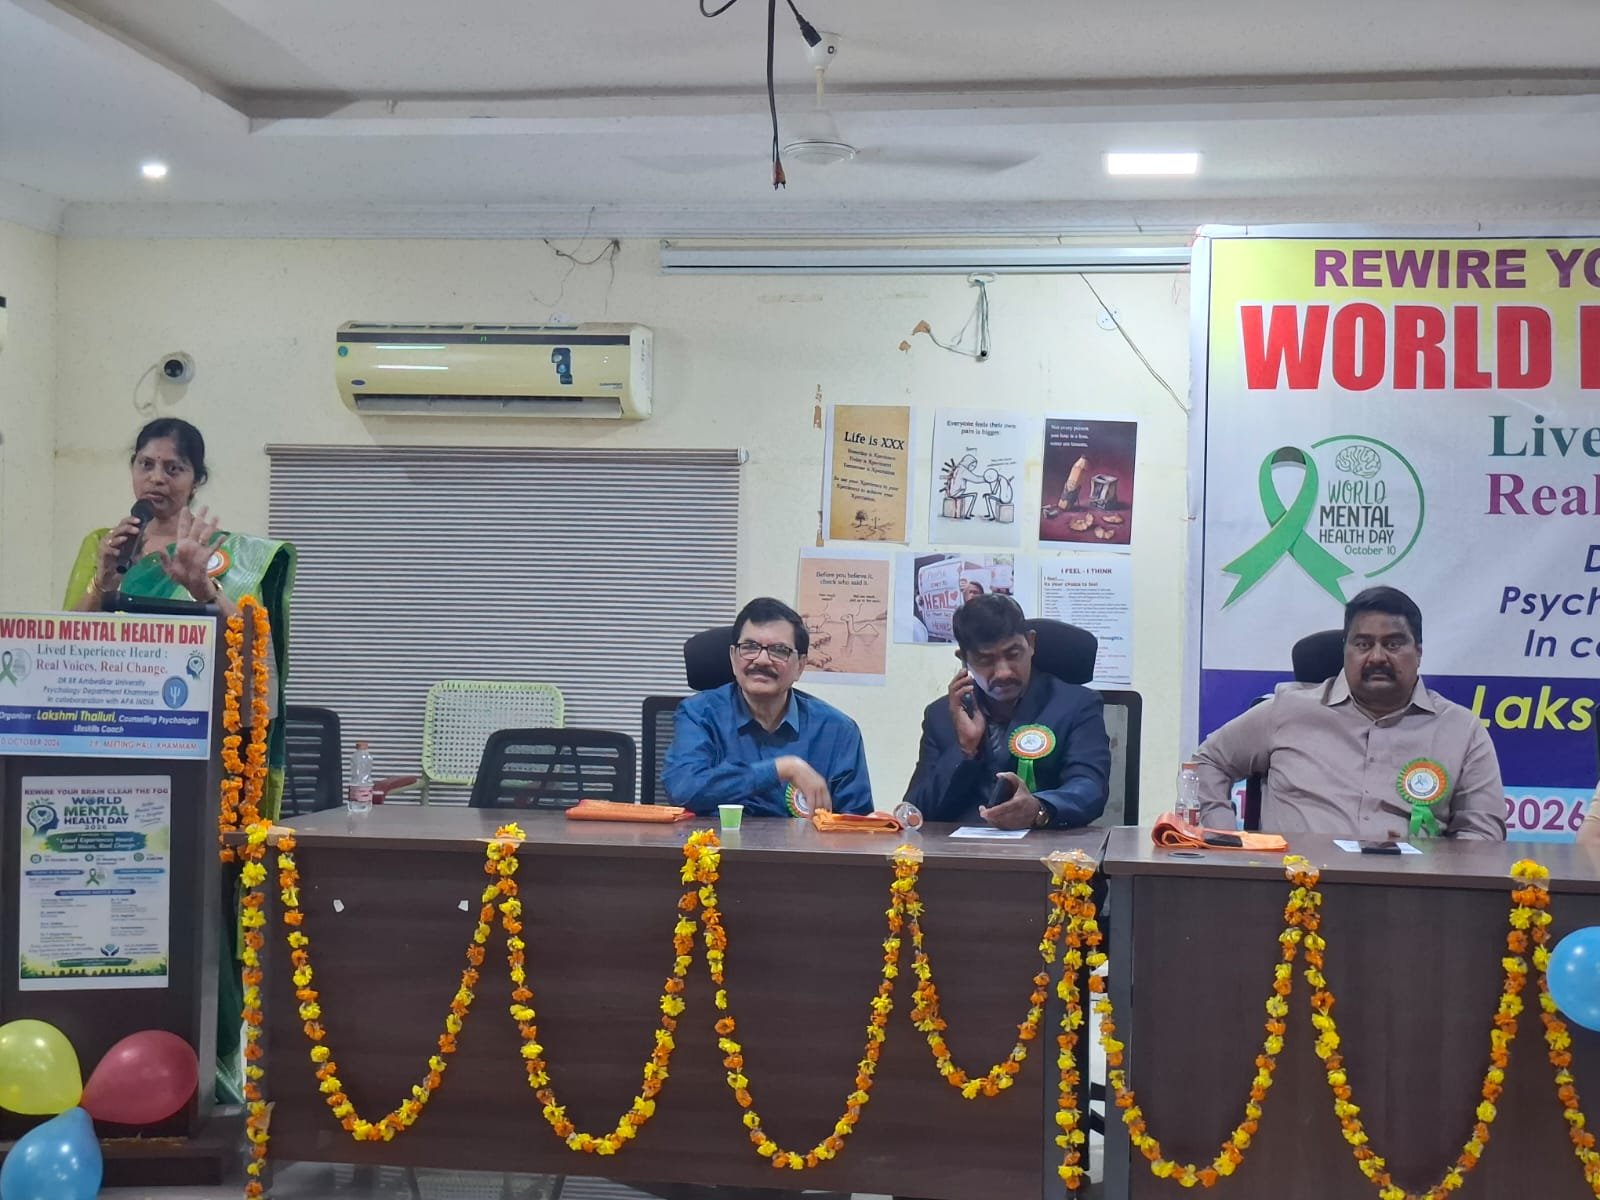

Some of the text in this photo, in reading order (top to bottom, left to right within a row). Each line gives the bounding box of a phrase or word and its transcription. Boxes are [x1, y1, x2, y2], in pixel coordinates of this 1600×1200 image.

[1314, 249, 1527, 289] REWIRE
[1240, 302, 1552, 391] WORLD
[946, 420, 974, 428] Everyone
[844, 431, 905, 451] Life is XXX
[1328, 480, 1386, 505] WORLD
[1484, 473, 1600, 516] Real
[1320, 505, 1394, 528] MENTAL
[1319, 529, 1394, 544] HEALTH DAY
[1344, 545, 1396, 555] October 10
[0, 619, 207, 644] WORLD MENTAL HEALTH DAY
[37, 643, 66, 655] Lived
[70, 645, 127, 659] Experience
[129, 647, 161, 658] Heard
[1524, 629, 1557, 657] In
[36, 659, 60, 670] Real
[63, 660, 97, 672] Voices,
[100, 661, 123, 672] Real
[126, 662, 168, 675] Change.
[36, 710, 79, 721] Lakshmi
[72, 797, 122, 805] WORLD
[64, 806, 129, 816] MENTAL
[64, 817, 104, 825] HEALTH
